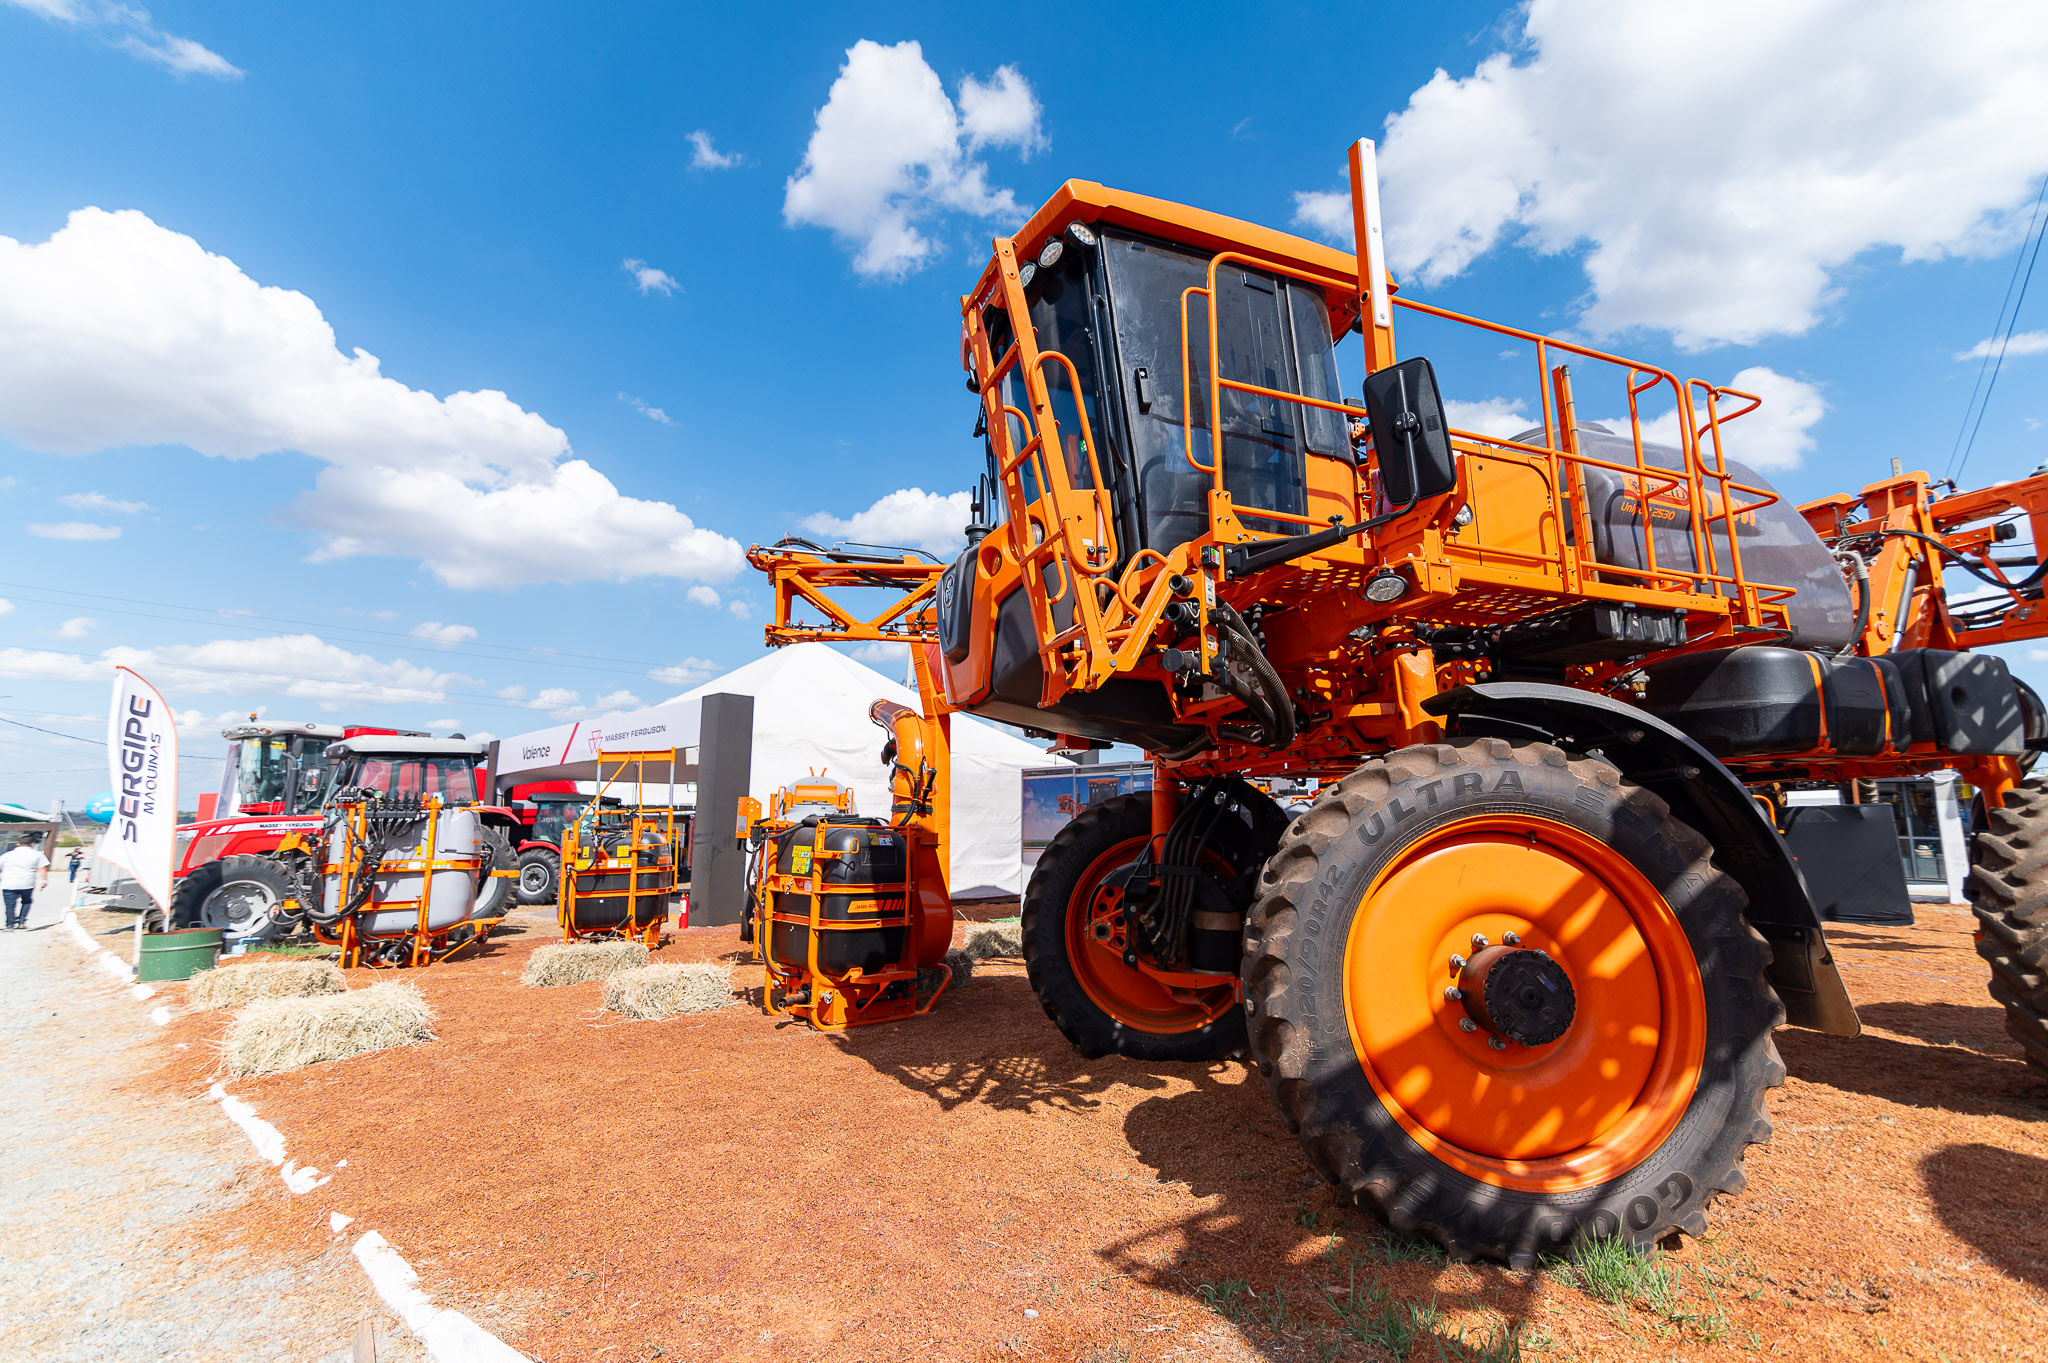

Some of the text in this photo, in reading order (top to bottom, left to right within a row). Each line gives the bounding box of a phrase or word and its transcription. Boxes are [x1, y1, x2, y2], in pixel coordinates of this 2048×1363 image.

[1652, 506, 1676, 520] 2530
[522, 745, 550, 760] Valence
[604, 725, 666, 742] MASSEY FERGUSON
[119, 694, 152, 843] SERGIPE
[1355, 770, 1526, 846] ULTRA
[1298, 864, 1345, 1031] 320/90R42
